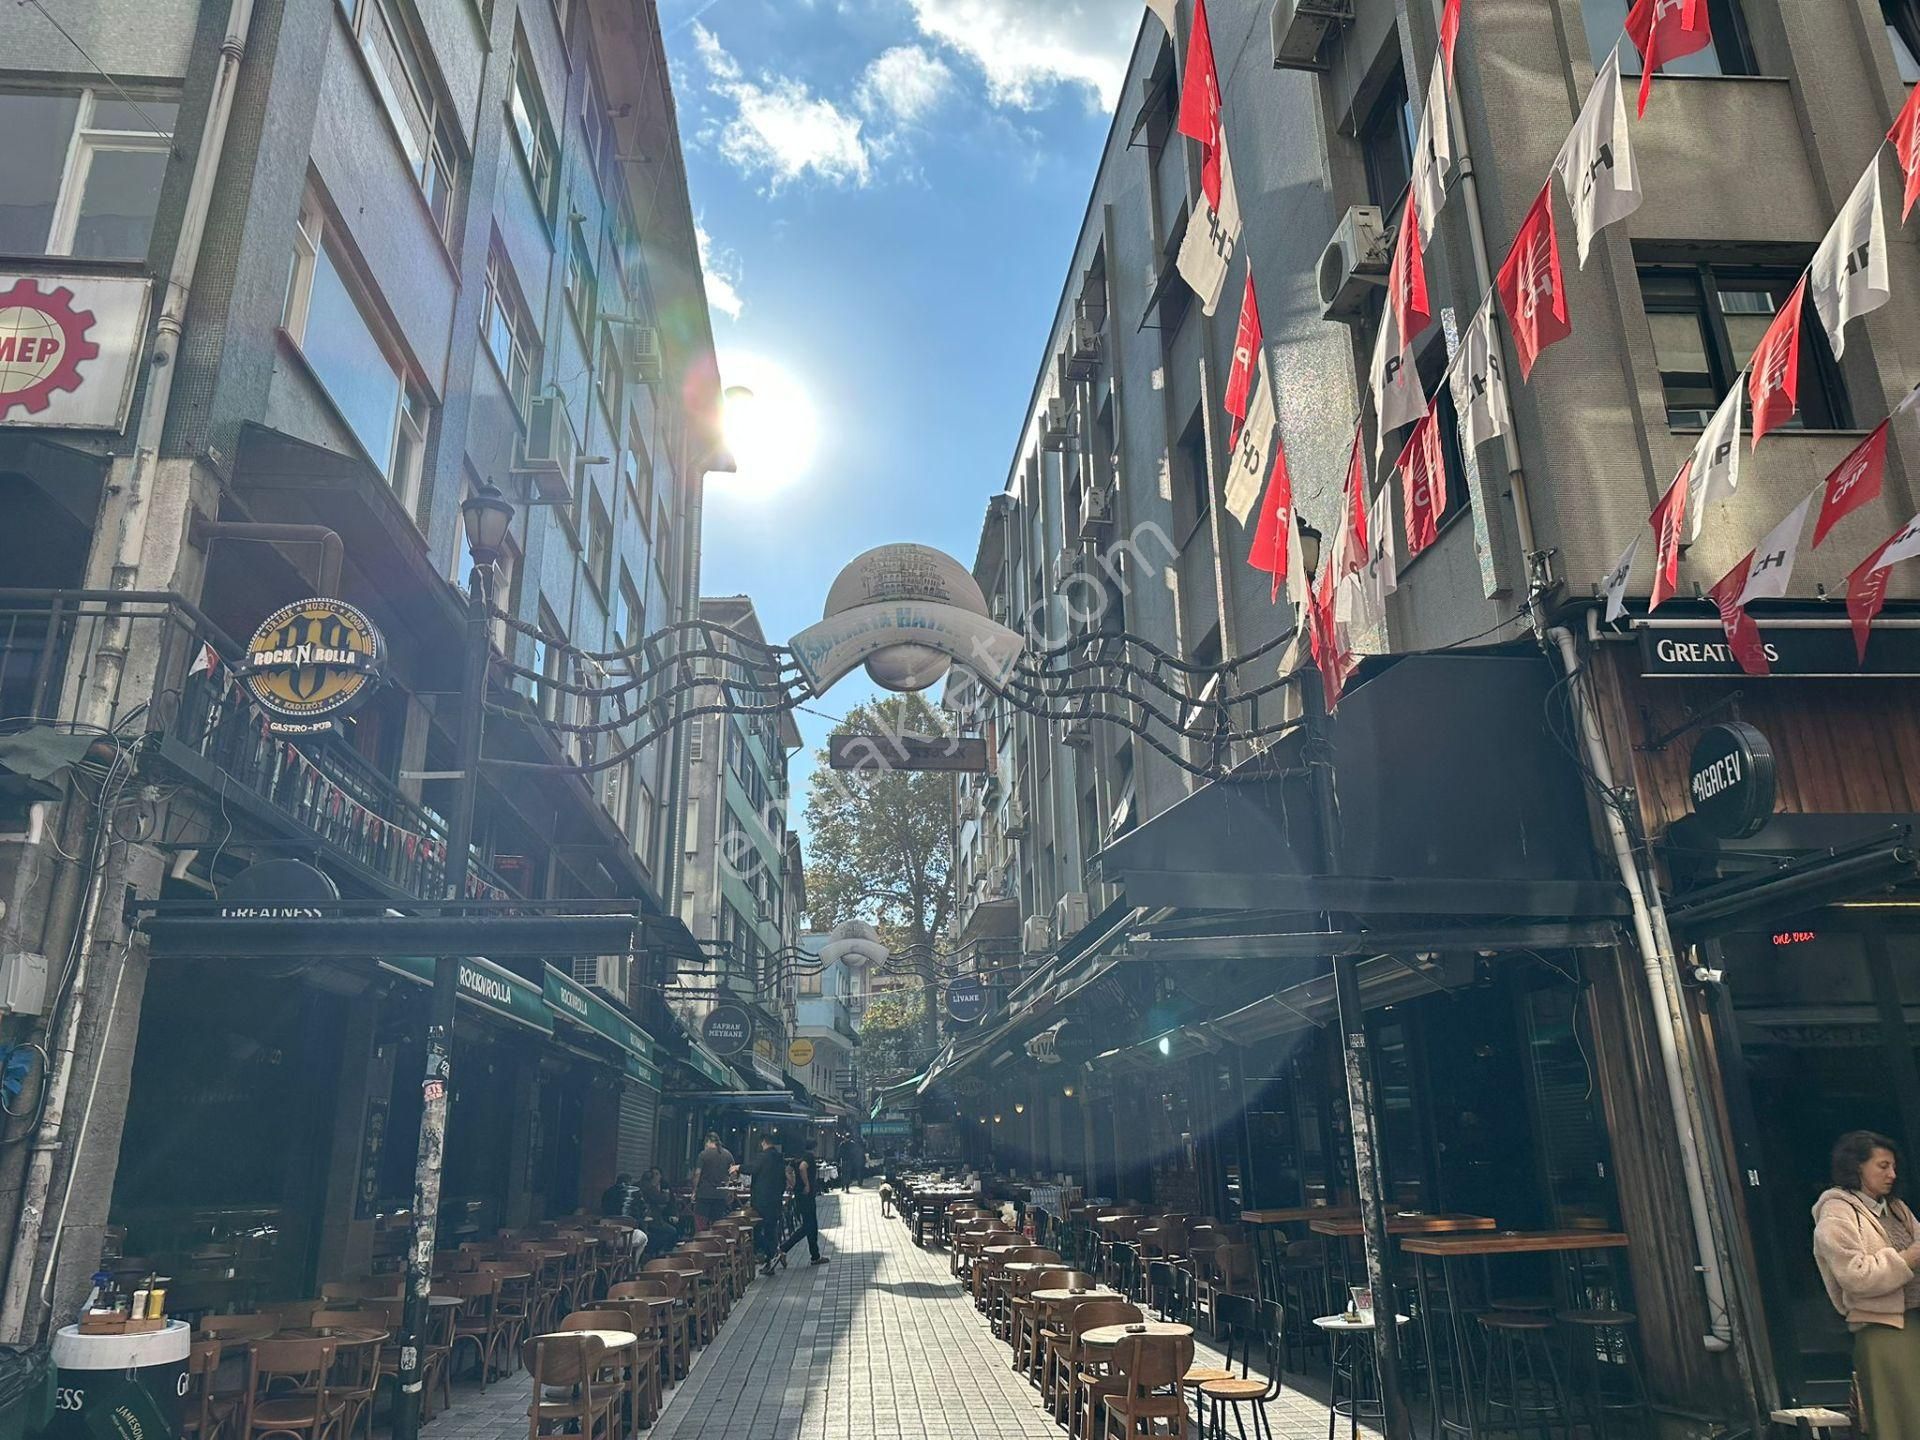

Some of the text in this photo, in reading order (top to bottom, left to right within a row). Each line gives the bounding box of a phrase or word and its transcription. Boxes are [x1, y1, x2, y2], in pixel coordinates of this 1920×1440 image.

[1832, 461, 1868, 504] CHP
[266, 602, 365, 633] DRINK MUSIC FOOD
[254, 642, 355, 670] ROCK N ROLLA
[270, 721, 331, 732] GASTRO-PUB
[459, 966, 512, 1004] ROCKNROLLA
[709, 1030, 743, 1038] MEYHANE
